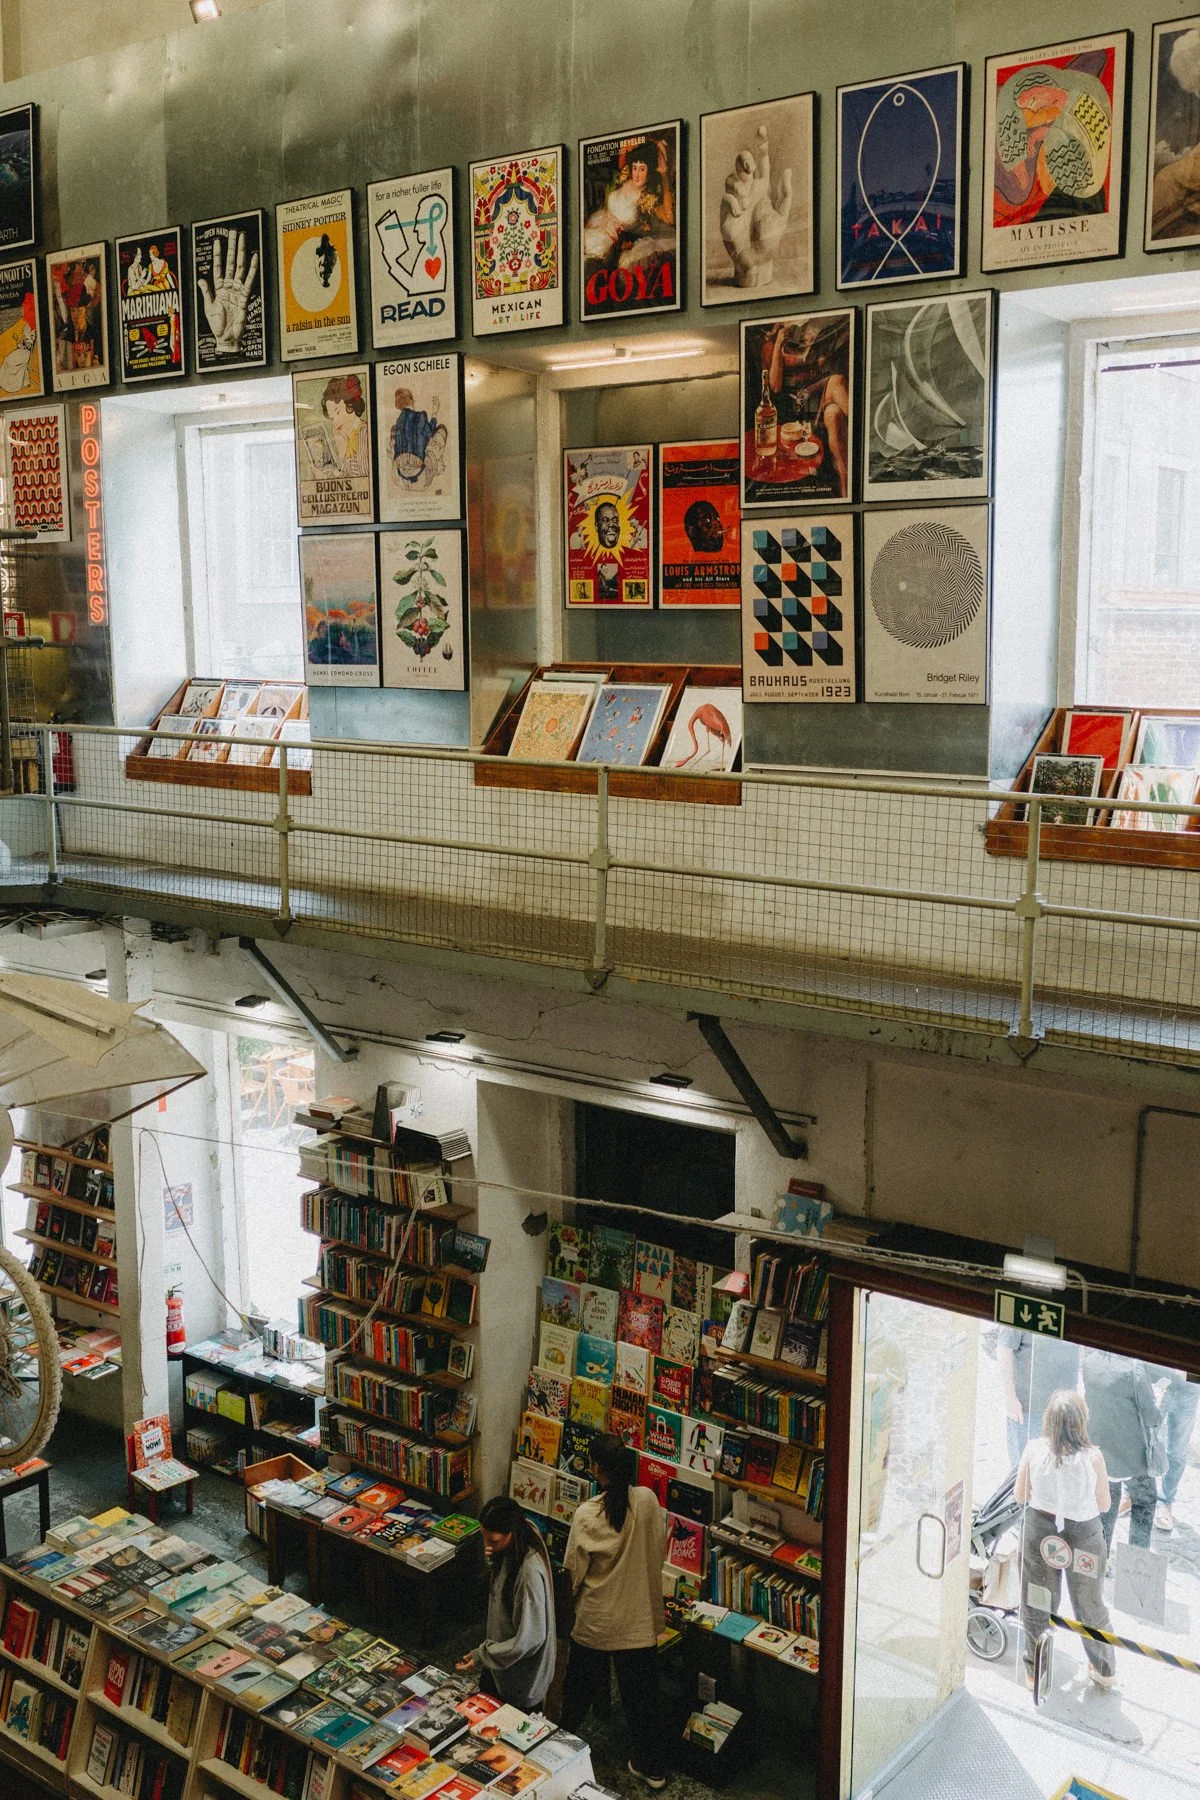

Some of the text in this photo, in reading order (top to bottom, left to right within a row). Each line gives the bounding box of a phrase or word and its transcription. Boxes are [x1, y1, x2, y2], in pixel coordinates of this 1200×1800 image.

[587, 136, 646, 154] FONDATION BEYELER
[376, 192, 386, 201] for
[412, 183, 430, 195] fuller
[430, 180, 442, 190] life
[285, 201, 320, 215] THEATRICAL
[282, 211, 347, 233] SIDNEY POITIER
[851, 212, 942, 239] TAKAI
[1011, 219, 1090, 241] MATISSE
[204, 227, 229, 239] OPEN HAND
[586, 260, 674, 305] GOYA
[121, 290, 180, 321] MARIHUANA
[247, 296, 262, 312] OPEN
[380, 297, 446, 325] READ
[491, 298, 542, 315] MEXICAN
[246, 306, 262, 322] HAND
[493, 315, 510, 325] ART
[520, 311, 541, 322] LIFE
[286, 315, 351, 333] a raisin in the sun
[383, 358, 450, 376] EGON SCHIELE
[81, 404, 106, 624] POSTERS
[664, 566, 690, 577] LOUIS
[750, 676, 807, 686] BAUHAUS
[927, 673, 980, 684] Bridget Riley
[821, 686, 851, 697] 1923
[637, 1242, 671, 1265] PRAIA
[576, 1381, 586, 1389] THE
[612, 1384, 645, 1404] HUMAN
[611, 1397, 644, 1418] RIGHTS
[674, 1536, 696, 1549] DING
[71, 1634, 86, 1649] Irão
